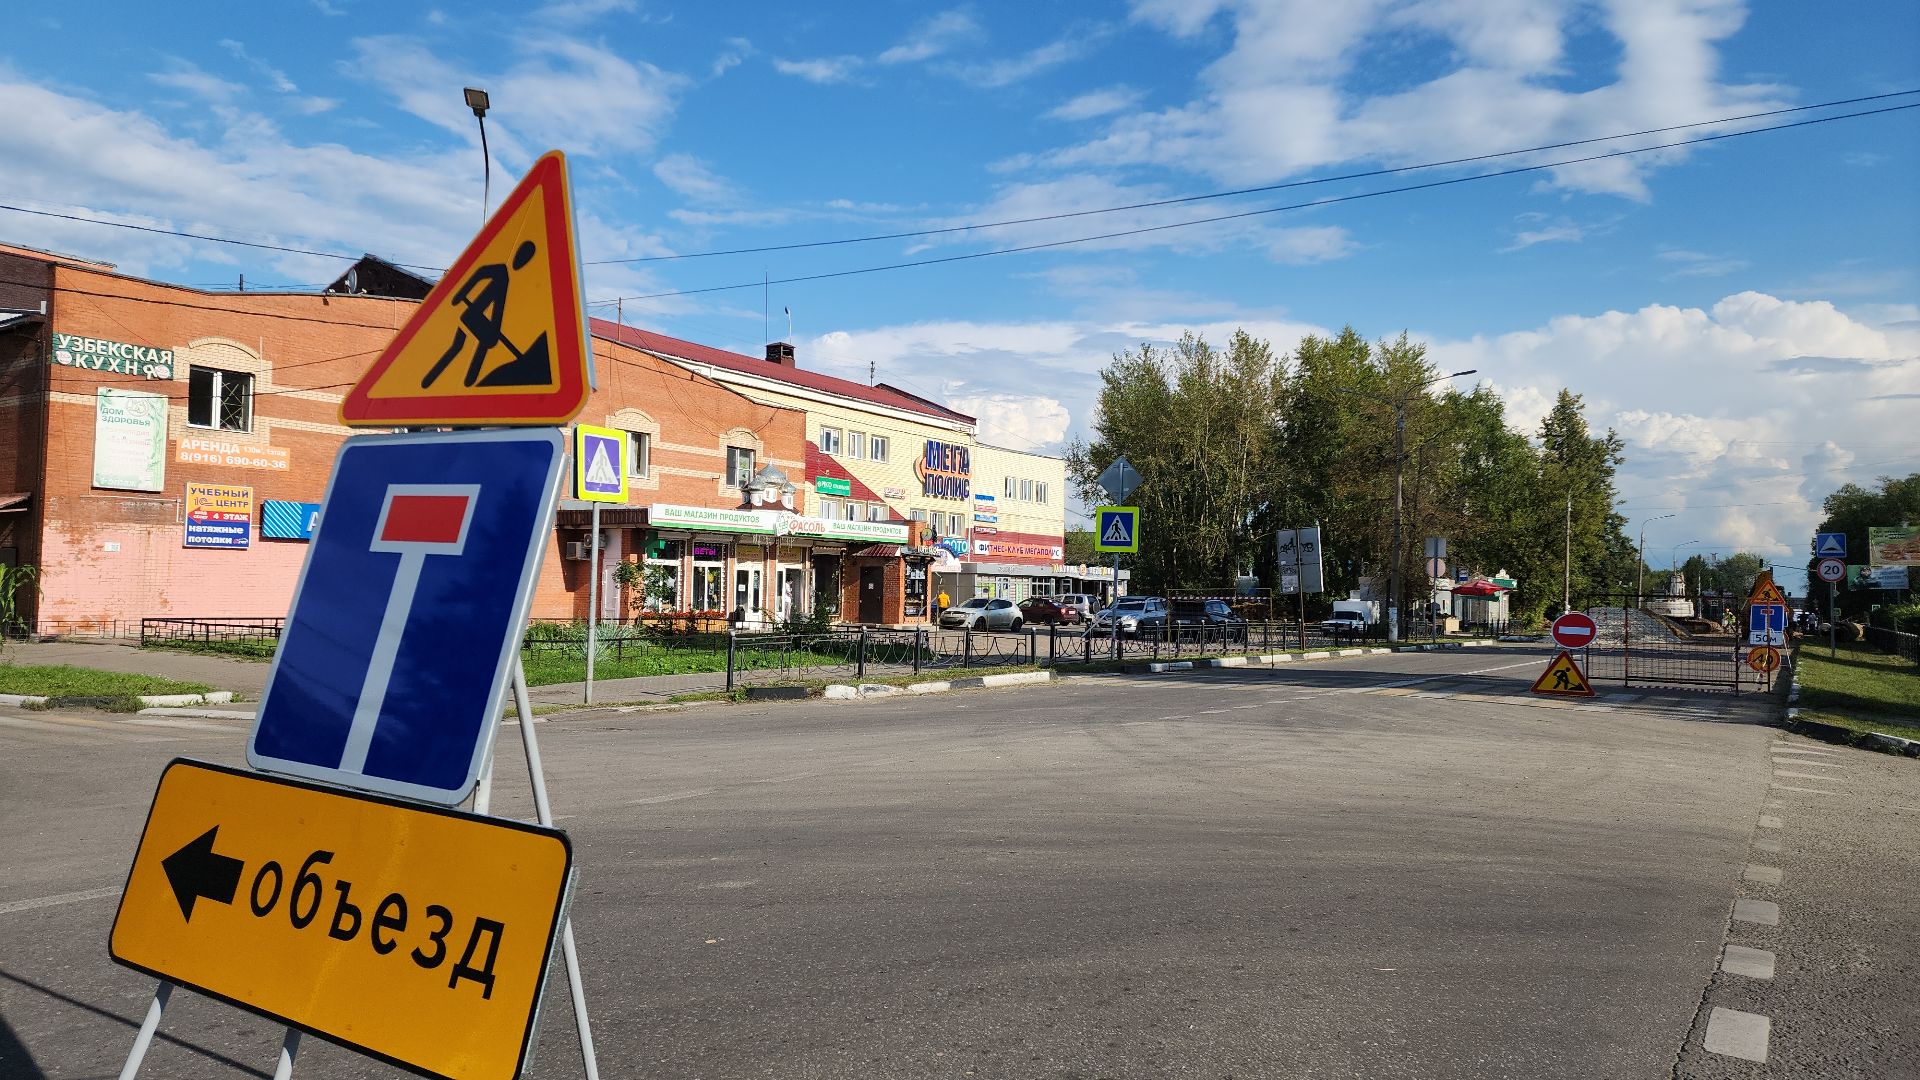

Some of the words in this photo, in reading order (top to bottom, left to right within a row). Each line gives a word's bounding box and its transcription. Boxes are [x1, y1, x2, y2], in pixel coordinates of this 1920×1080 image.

[58, 333, 172, 365] УЗБЕКСКАЯ
[75, 353, 158, 380] КУХНЯ
[102, 407, 124, 415] ДОМ
[101, 416, 151, 426] ЗДОРОВЬЯ
[181, 439, 240, 454] АРЕНДА
[180, 452, 222, 465] 8(916)
[226, 455, 287, 469] 690-60-36
[926, 439, 970, 474] МЕГА
[924, 473, 970, 498] ПОЛИС
[191, 487, 249, 498] УЧЕБНЫЙ
[216, 500, 249, 508] ЦЕНТР
[212, 512, 219, 520] 4
[223, 513, 249, 521] ЭТАЖ
[664, 508, 682, 517] ВАШ
[684, 510, 717, 519] МАГАЗИН
[719, 513, 760, 523] ПРОДУКТОВ
[188, 525, 244, 534] натяжные
[788, 520, 826, 533] ФАСОЛЬ
[832, 522, 846, 530] ВАШ
[187, 536, 232, 544] потолки
[978, 543, 1023, 554] ФИТНЕС-КЛУБ
[1823, 565, 1840, 575] 20
[250, 849, 505, 1000] объезд
